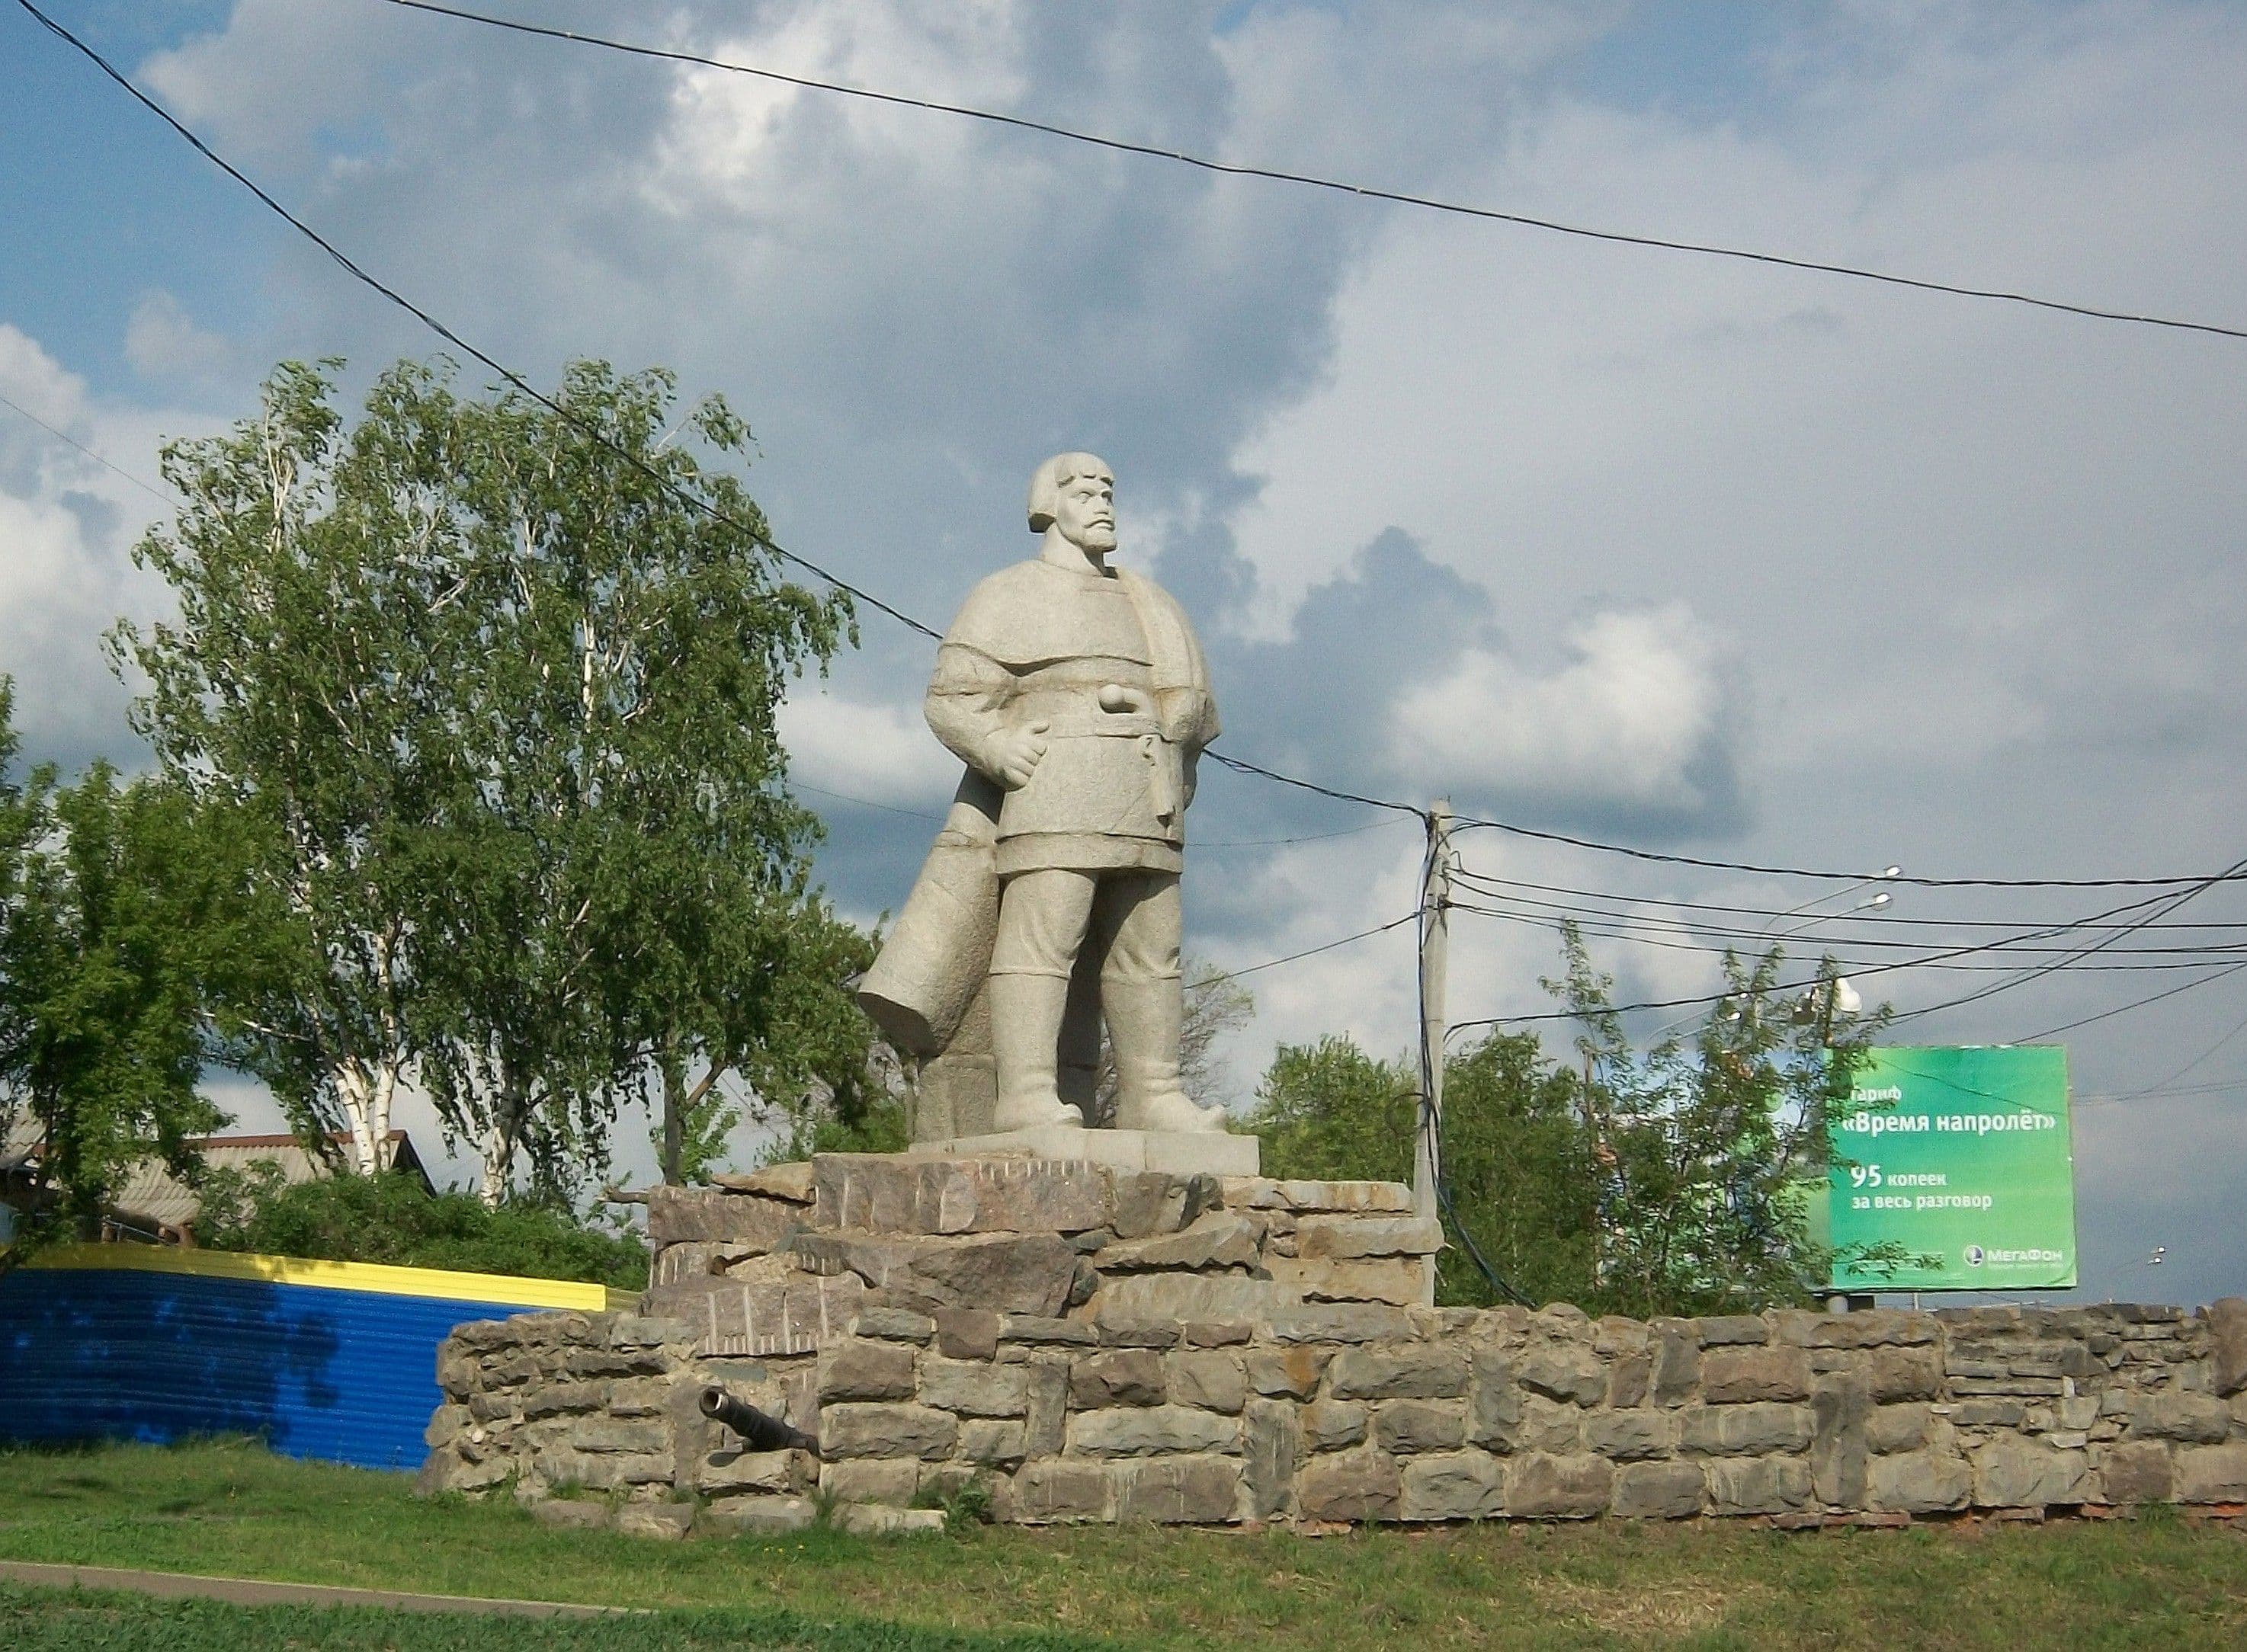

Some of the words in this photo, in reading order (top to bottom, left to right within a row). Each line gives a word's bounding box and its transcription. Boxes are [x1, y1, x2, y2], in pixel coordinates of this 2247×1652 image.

[1842, 1111, 1930, 1137] «Время
[1936, 1109, 2056, 1136] напролёт»
[1851, 1164, 1883, 1188] 95
[1887, 1173, 1947, 1186] копеек
[1851, 1196, 1870, 1209] за
[1874, 1196, 1912, 1209] весь
[1916, 1196, 1992, 1211] разговор
